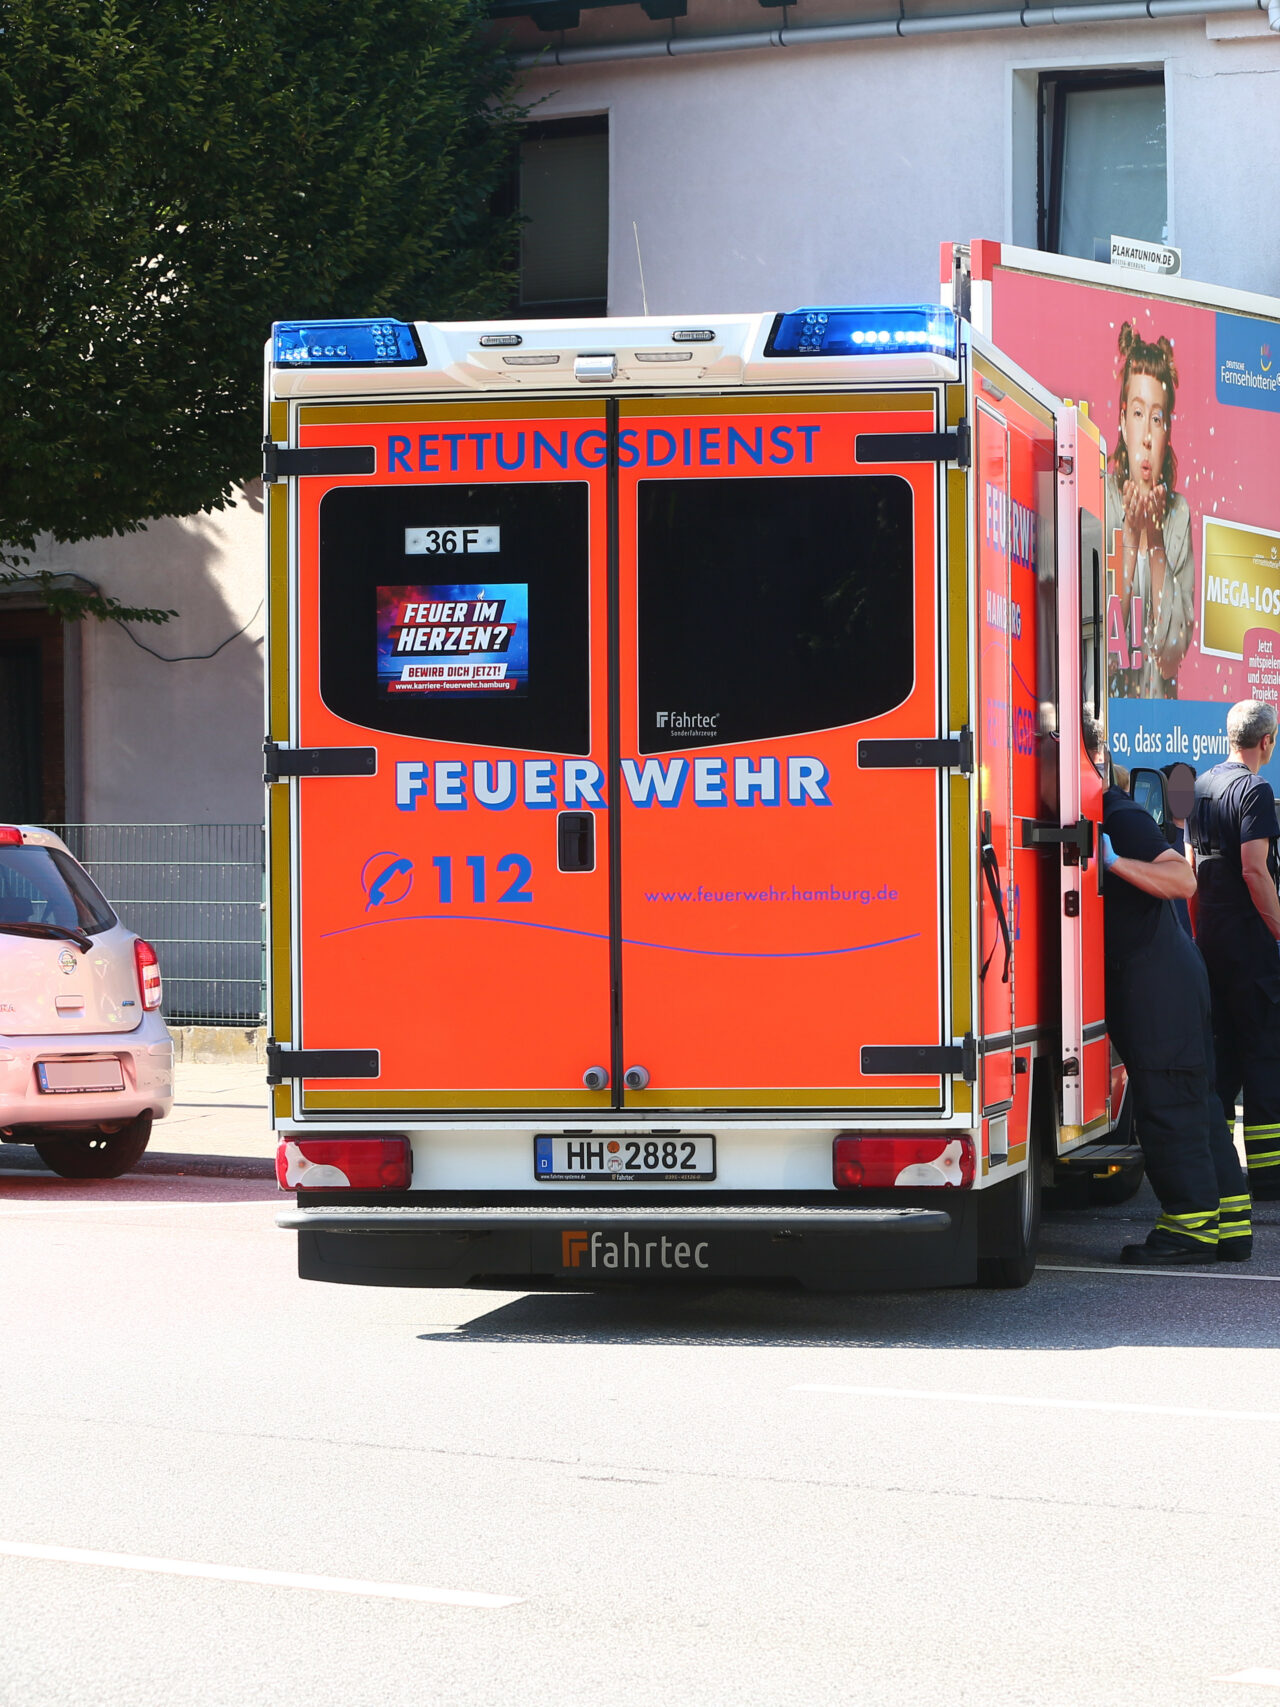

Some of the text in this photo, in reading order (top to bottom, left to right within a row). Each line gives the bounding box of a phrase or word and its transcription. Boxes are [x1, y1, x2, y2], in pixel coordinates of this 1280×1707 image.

[1112, 244, 1172, 266] PLAKATUNION.DE
[388, 425, 821, 473] RETTUNGSDIENST
[425, 529, 479, 554] 36 F
[1206, 575, 1280, 616] MEGA-LOS
[403, 602, 499, 624] FEUER IM
[397, 626, 509, 652] HERZEN?
[1257, 639, 1273, 654] Jetzt
[408, 665, 502, 679] BEWIRB DICH JETZT!
[1247, 669, 1260, 684] und
[395, 680, 511, 690] www.karriere-feuerwehr.hamburg
[1251, 685, 1278, 702] Projekte
[670, 711, 717, 728] fahrtec
[1112, 731, 1131, 757] so,
[1134, 724, 1162, 753] dass
[1165, 725, 1189, 753] alle
[431, 853, 533, 905] 112
[644, 884, 899, 905] www.feuerwehr.hamburg.de
[541, 1159, 548, 1168] D
[567, 1141, 697, 1170] HH 2882
[591, 1231, 709, 1269] fahrtec
